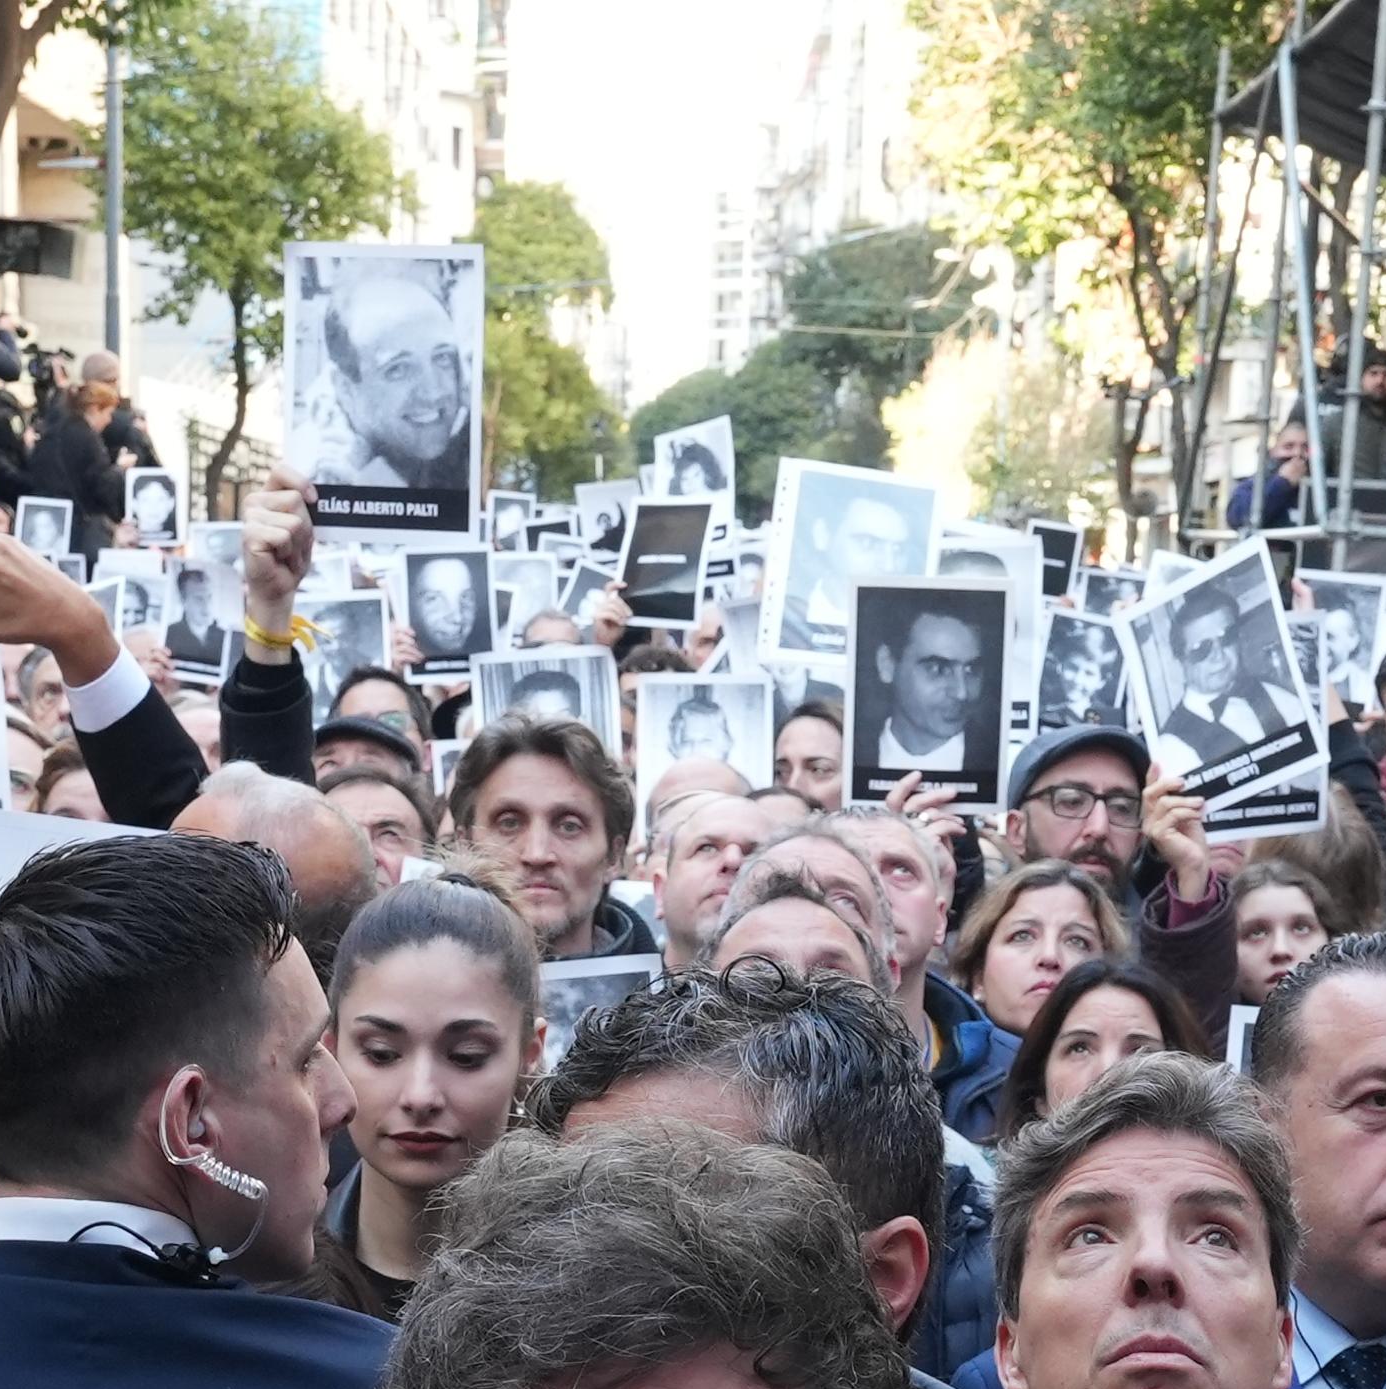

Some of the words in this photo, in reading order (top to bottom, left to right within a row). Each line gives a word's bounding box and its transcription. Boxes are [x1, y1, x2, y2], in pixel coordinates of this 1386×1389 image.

[317, 496, 351, 513] ELÍAS
[352, 500, 402, 516] ALBERTO
[407, 503, 439, 518] PALTI
